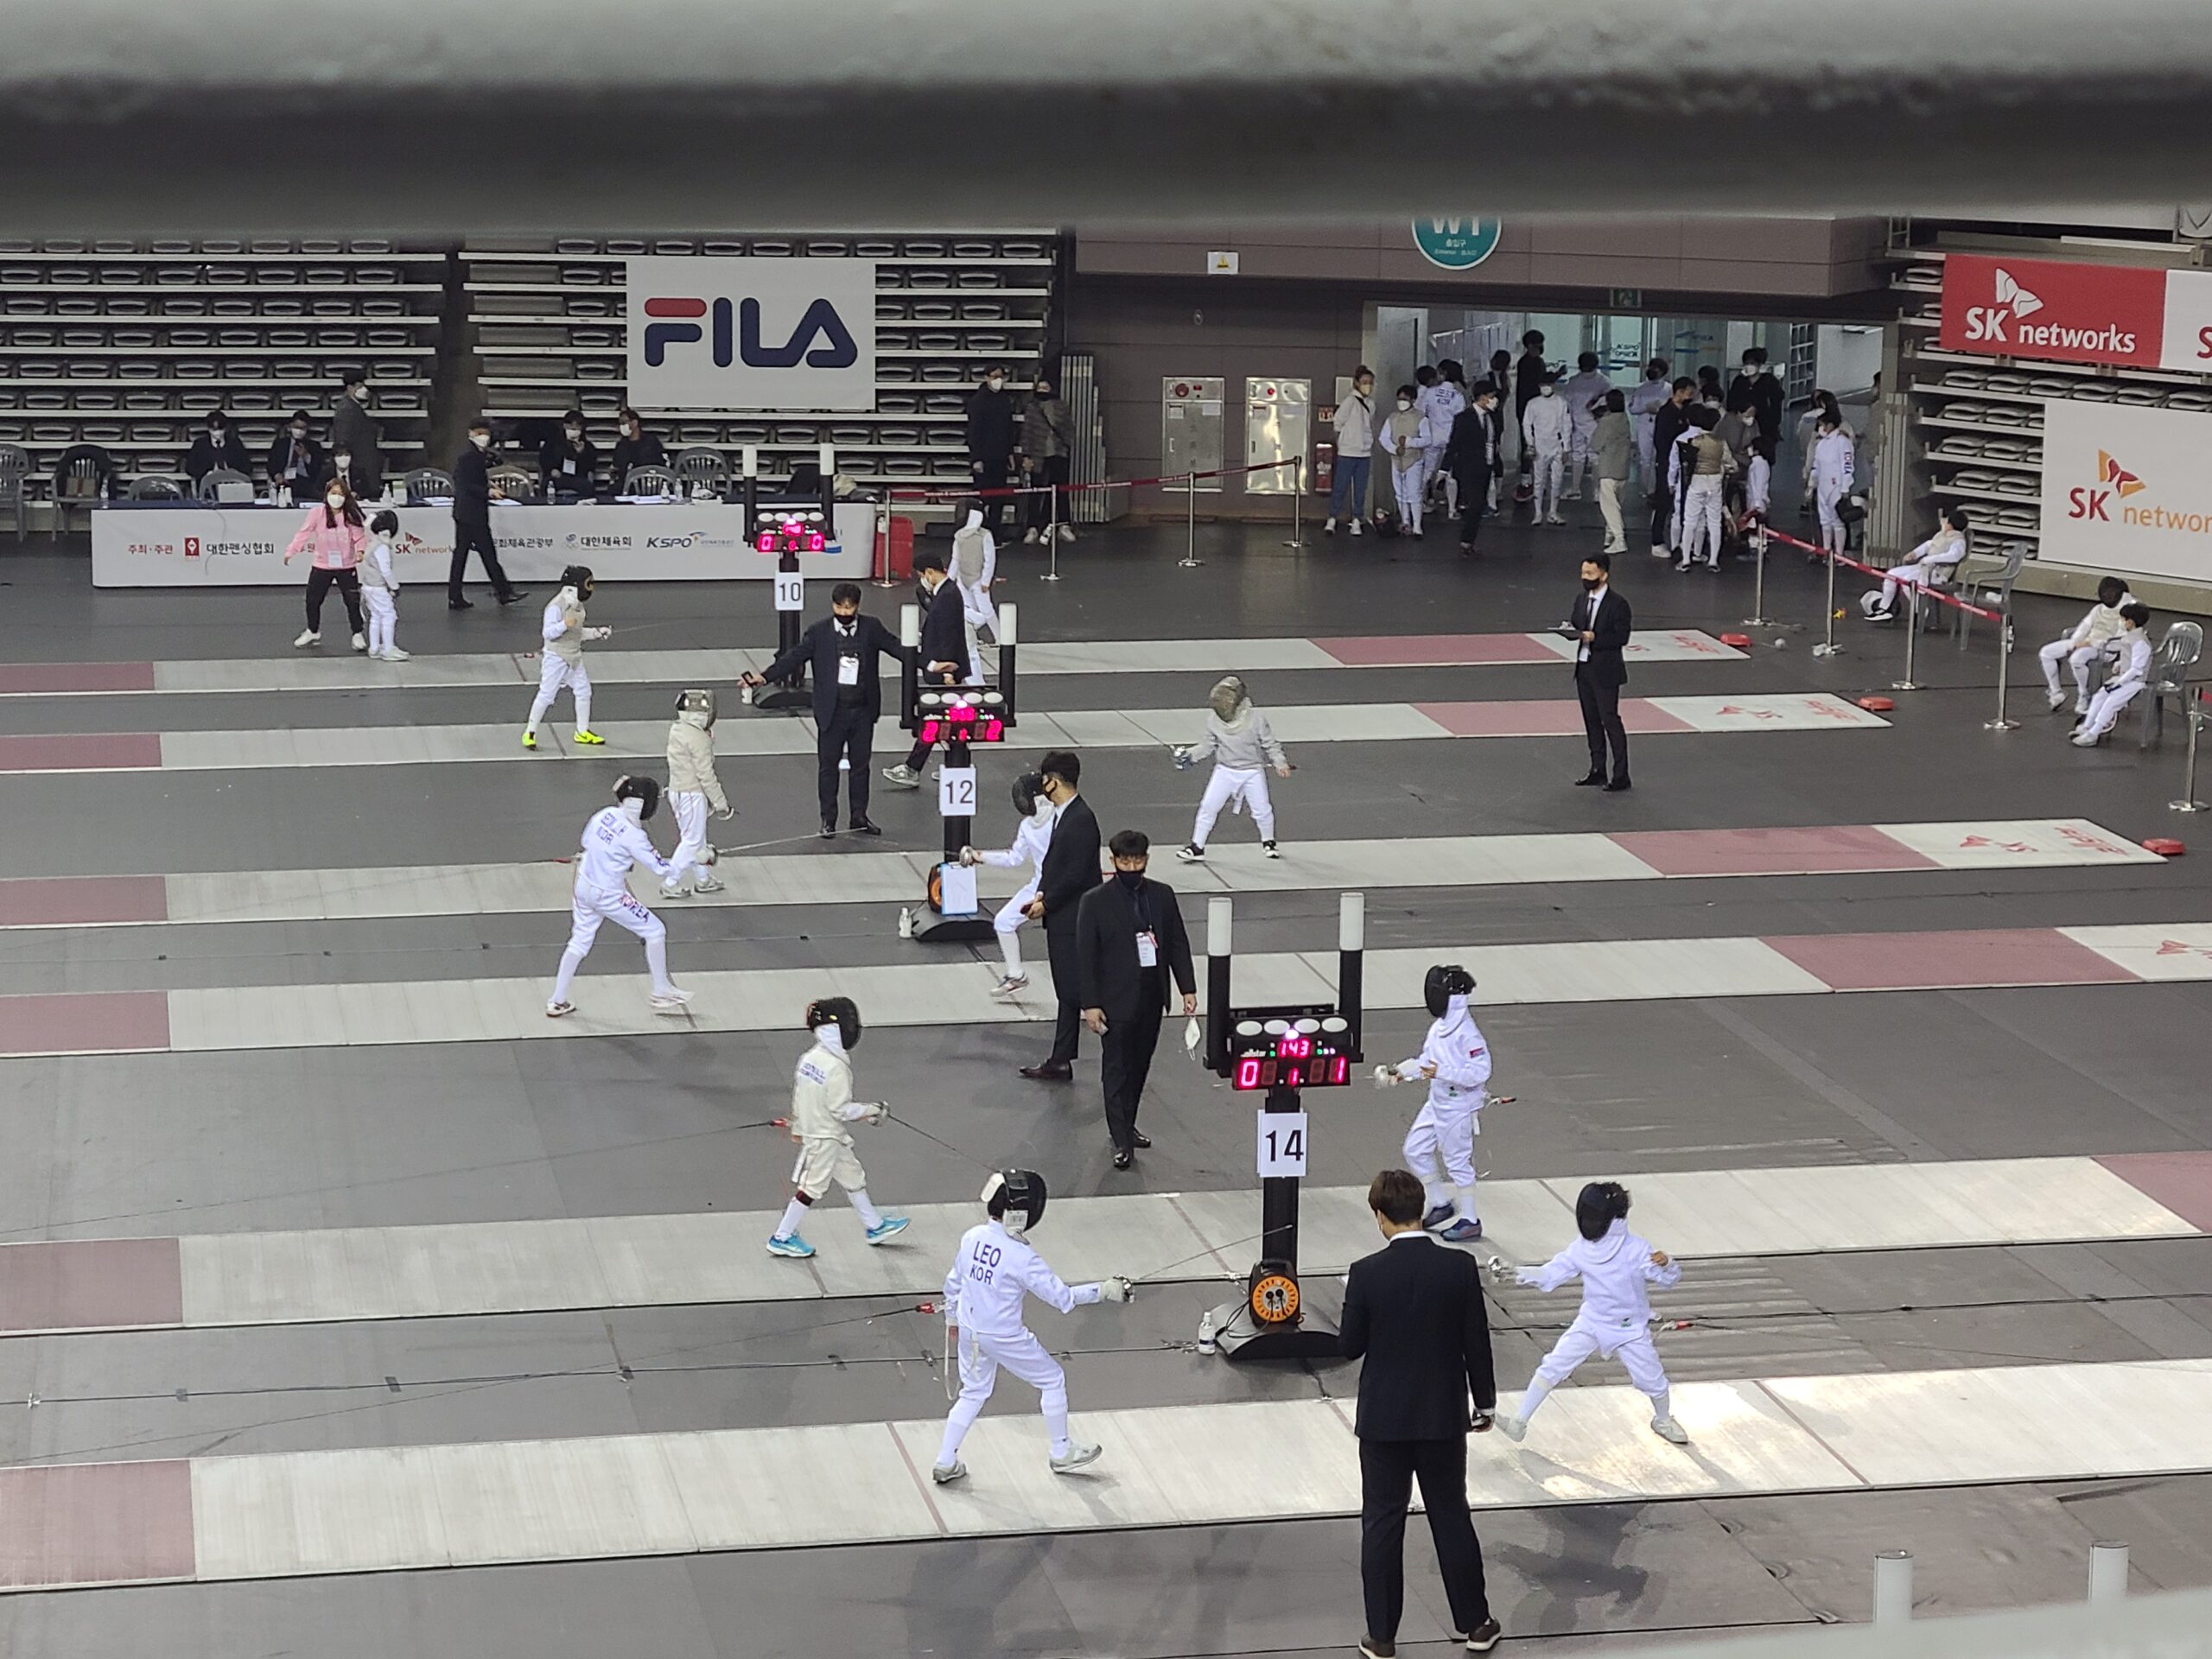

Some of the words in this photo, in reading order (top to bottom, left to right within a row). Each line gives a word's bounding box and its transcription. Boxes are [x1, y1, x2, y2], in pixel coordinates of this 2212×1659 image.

[644, 296, 858, 368] FILA
[1965, 306, 2010, 341] SK
[2018, 322, 2136, 353] networks
[2068, 486, 2111, 522] SK
[206, 543, 275, 556] 대한펜싱협회
[395, 543, 411, 555] SK
[646, 537, 692, 549] KSPO
[779, 582, 801, 602] 10
[945, 779, 974, 804] 12
[1240, 1060, 1260, 1088] 0
[1265, 1129, 1304, 1162] 14
[973, 1241, 1001, 1268] LEO
[969, 1264, 994, 1285] KOR
